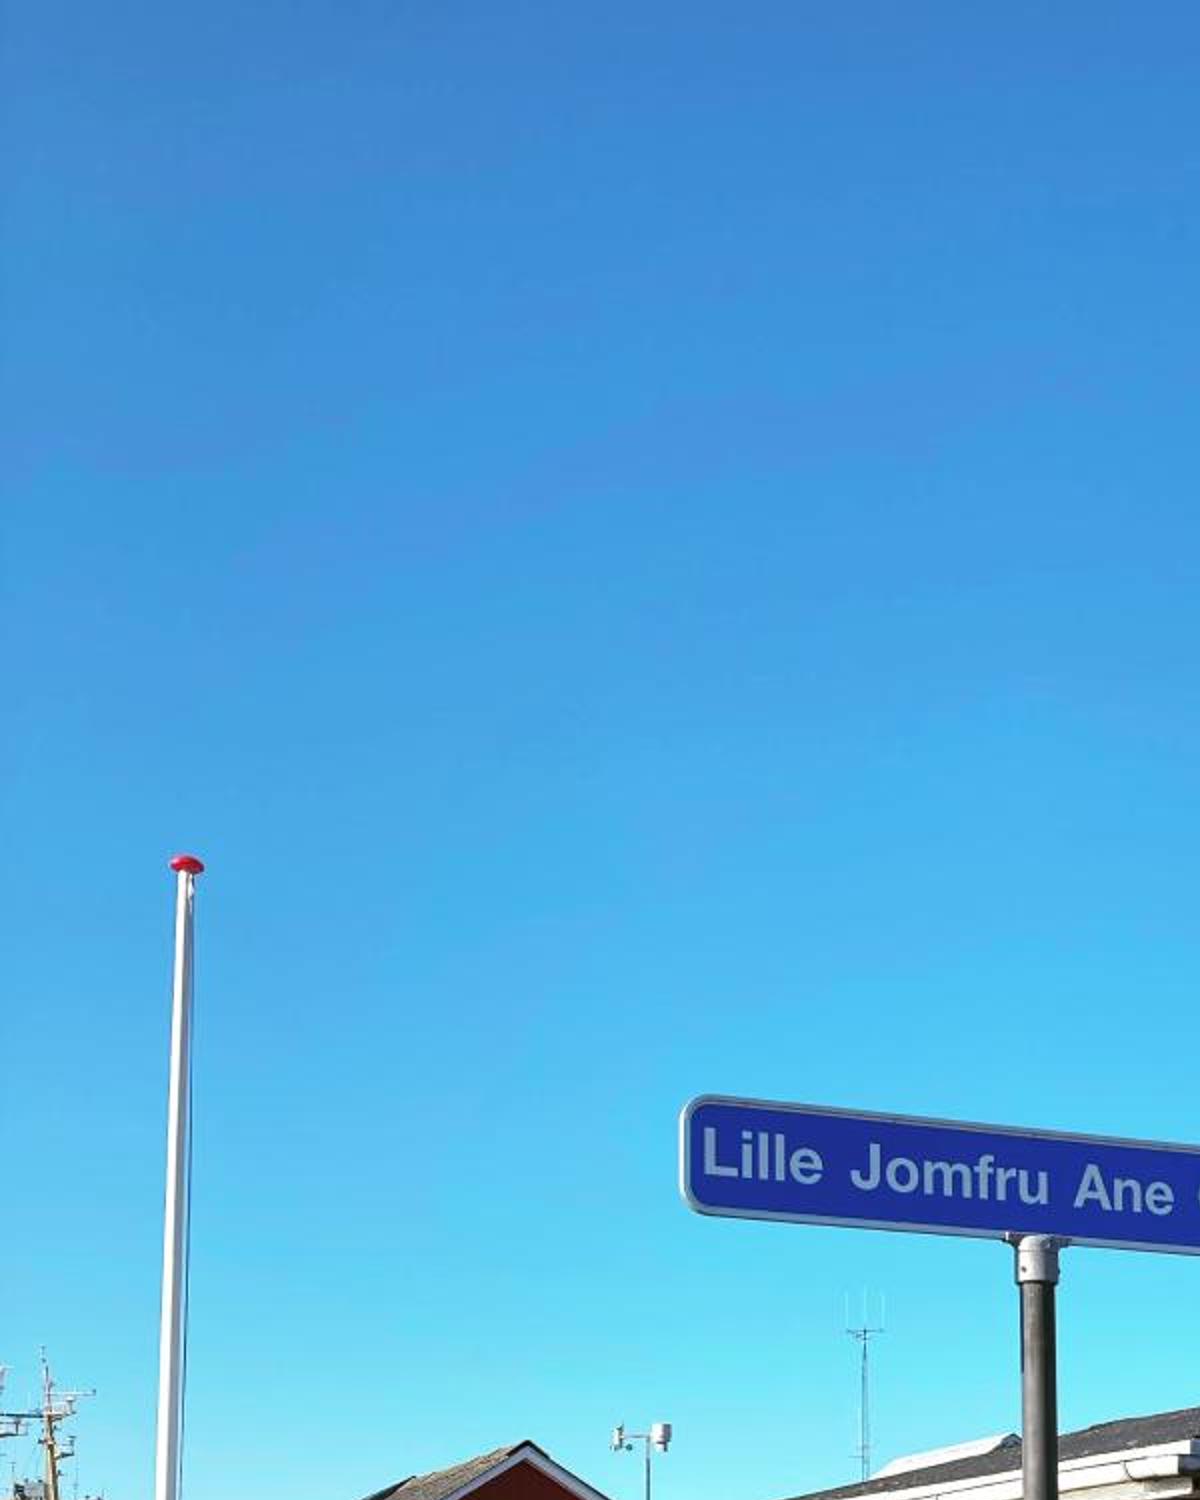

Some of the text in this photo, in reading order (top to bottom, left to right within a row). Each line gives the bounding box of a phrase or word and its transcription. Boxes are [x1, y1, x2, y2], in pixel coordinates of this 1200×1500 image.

[703, 1126, 824, 1185] Lille
[850, 1142, 1049, 1205] Jomfru
[1073, 1163, 1175, 1216] Ane
